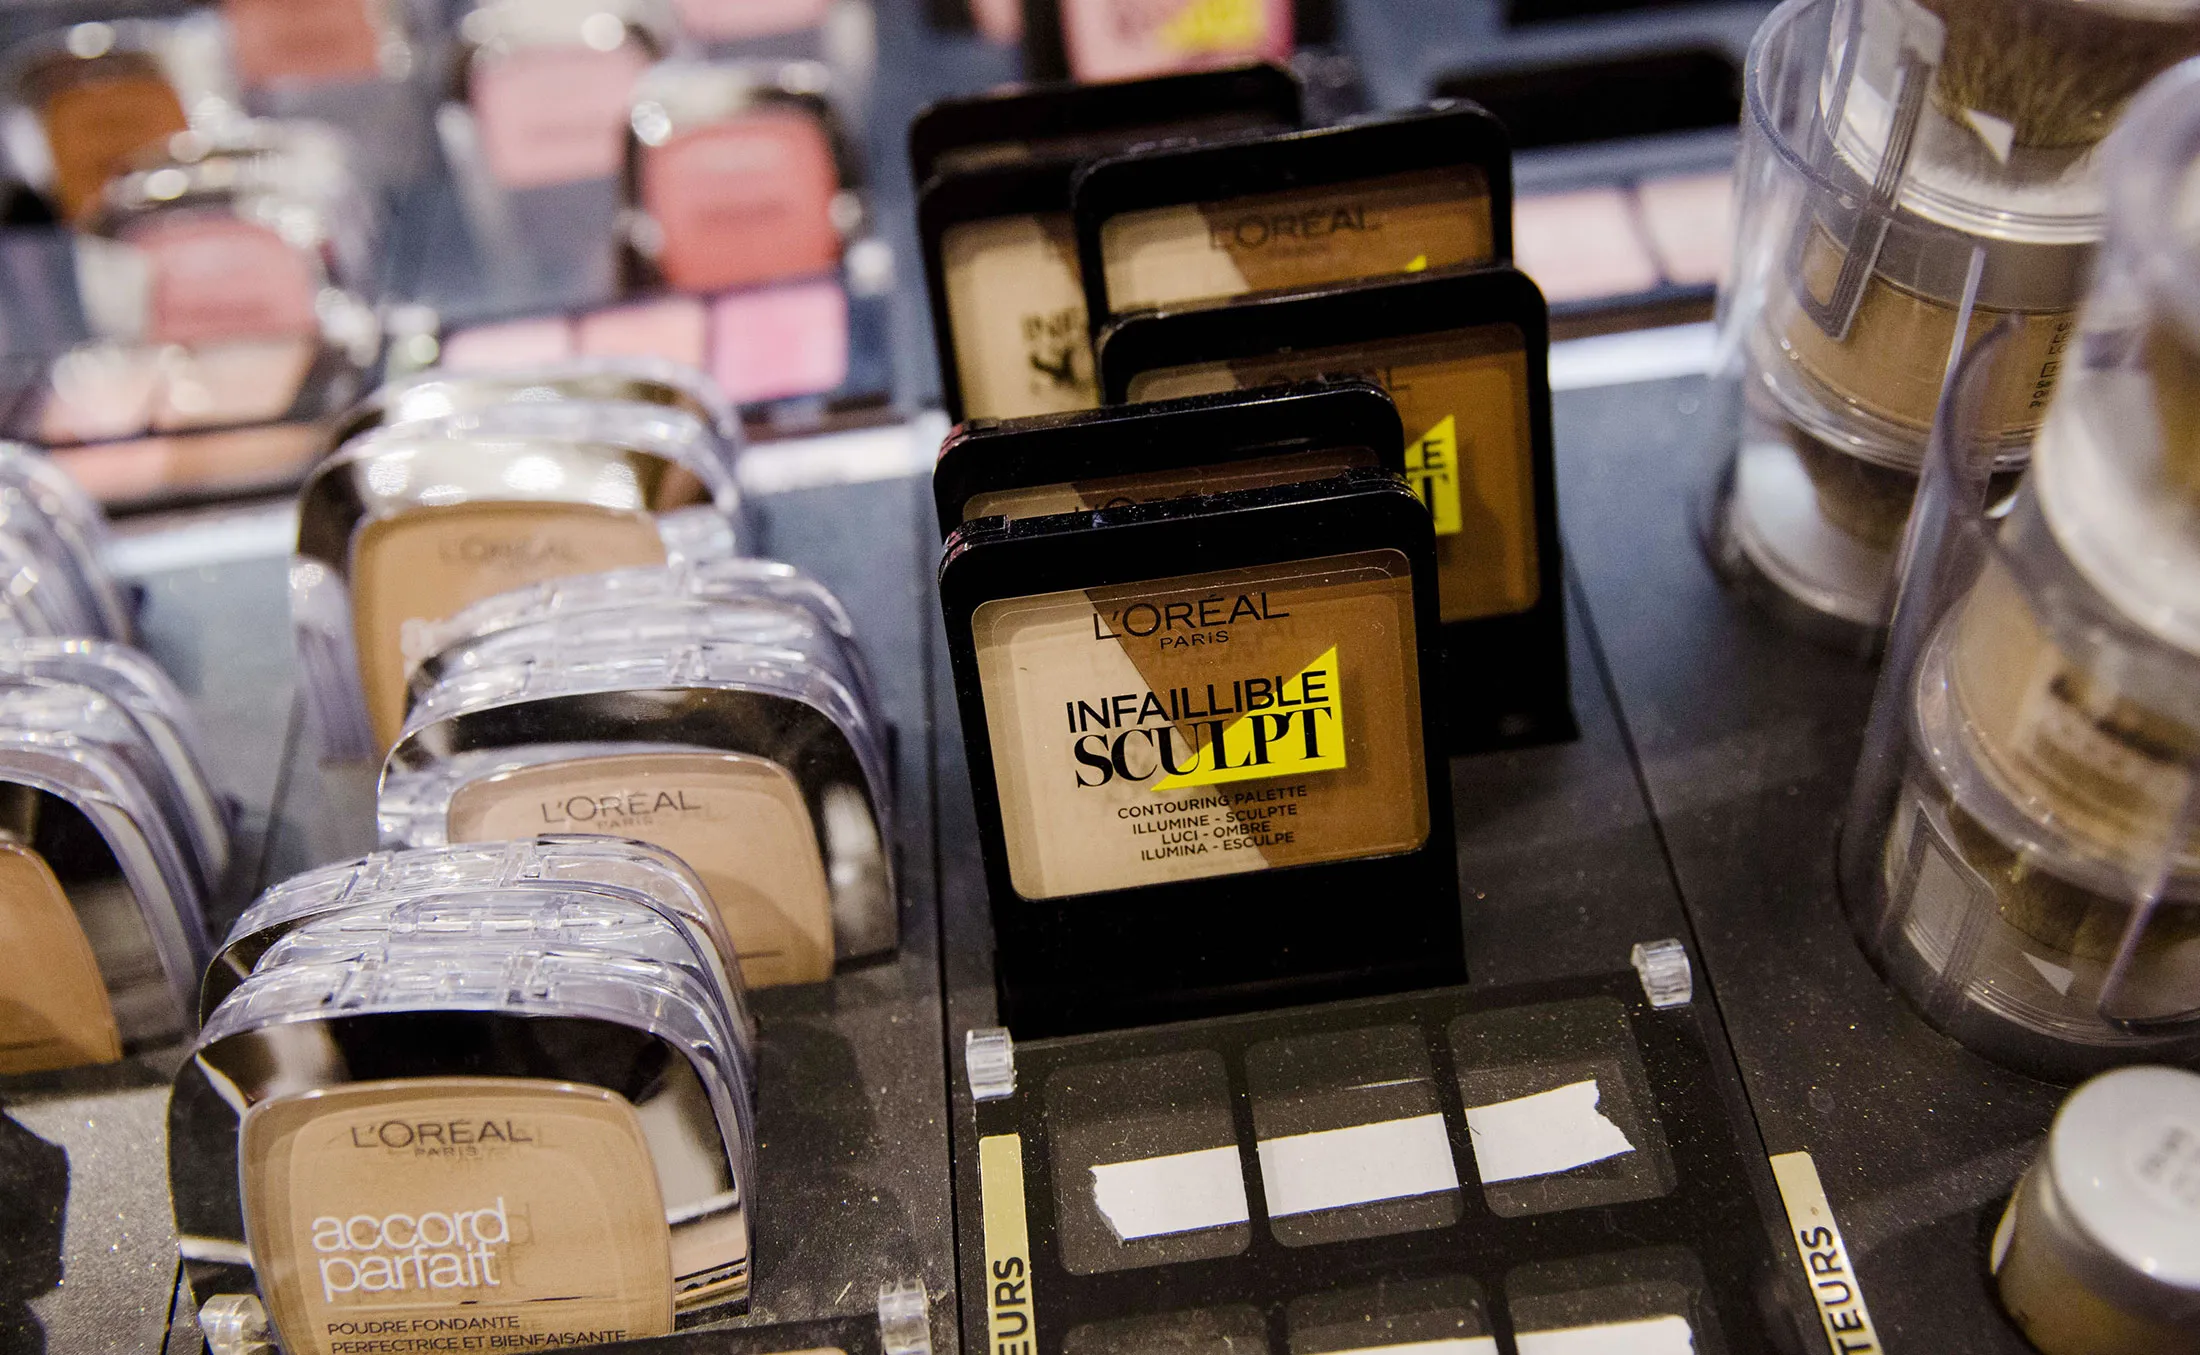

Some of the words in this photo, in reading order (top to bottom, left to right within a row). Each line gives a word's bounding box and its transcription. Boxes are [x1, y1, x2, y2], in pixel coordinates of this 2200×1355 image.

[1093, 592, 1289, 640] L'ORÉAL
[1066, 670, 1329, 733] INFAILLIBLE
[1074, 706, 1332, 788] SCULPT
[541, 791, 701, 823] L'ORÉAL
[1117, 795, 1230, 819] CONTOURING
[1234, 785, 1307, 805] PALETTE
[1132, 814, 1210, 835] ILLUMINE
[1225, 803, 1297, 823] SCULPTE
[1161, 830, 1198, 845] LUCI
[1213, 820, 1271, 838] OMBRE
[1141, 842, 1208, 861] ILUMINA
[1223, 831, 1295, 851] ESCULPE
[352, 1119, 533, 1148] L'ORÉAL
[311, 1196, 510, 1251] accord
[319, 1242, 500, 1303] parfait
[327, 1320, 408, 1335] POUDRE
[413, 1316, 520, 1331] FONDANTE
[331, 1337, 457, 1354] PERFECTRICE
[463, 1336, 485, 1349] ET
[491, 1329, 627, 1347] BIENFAISANTE
